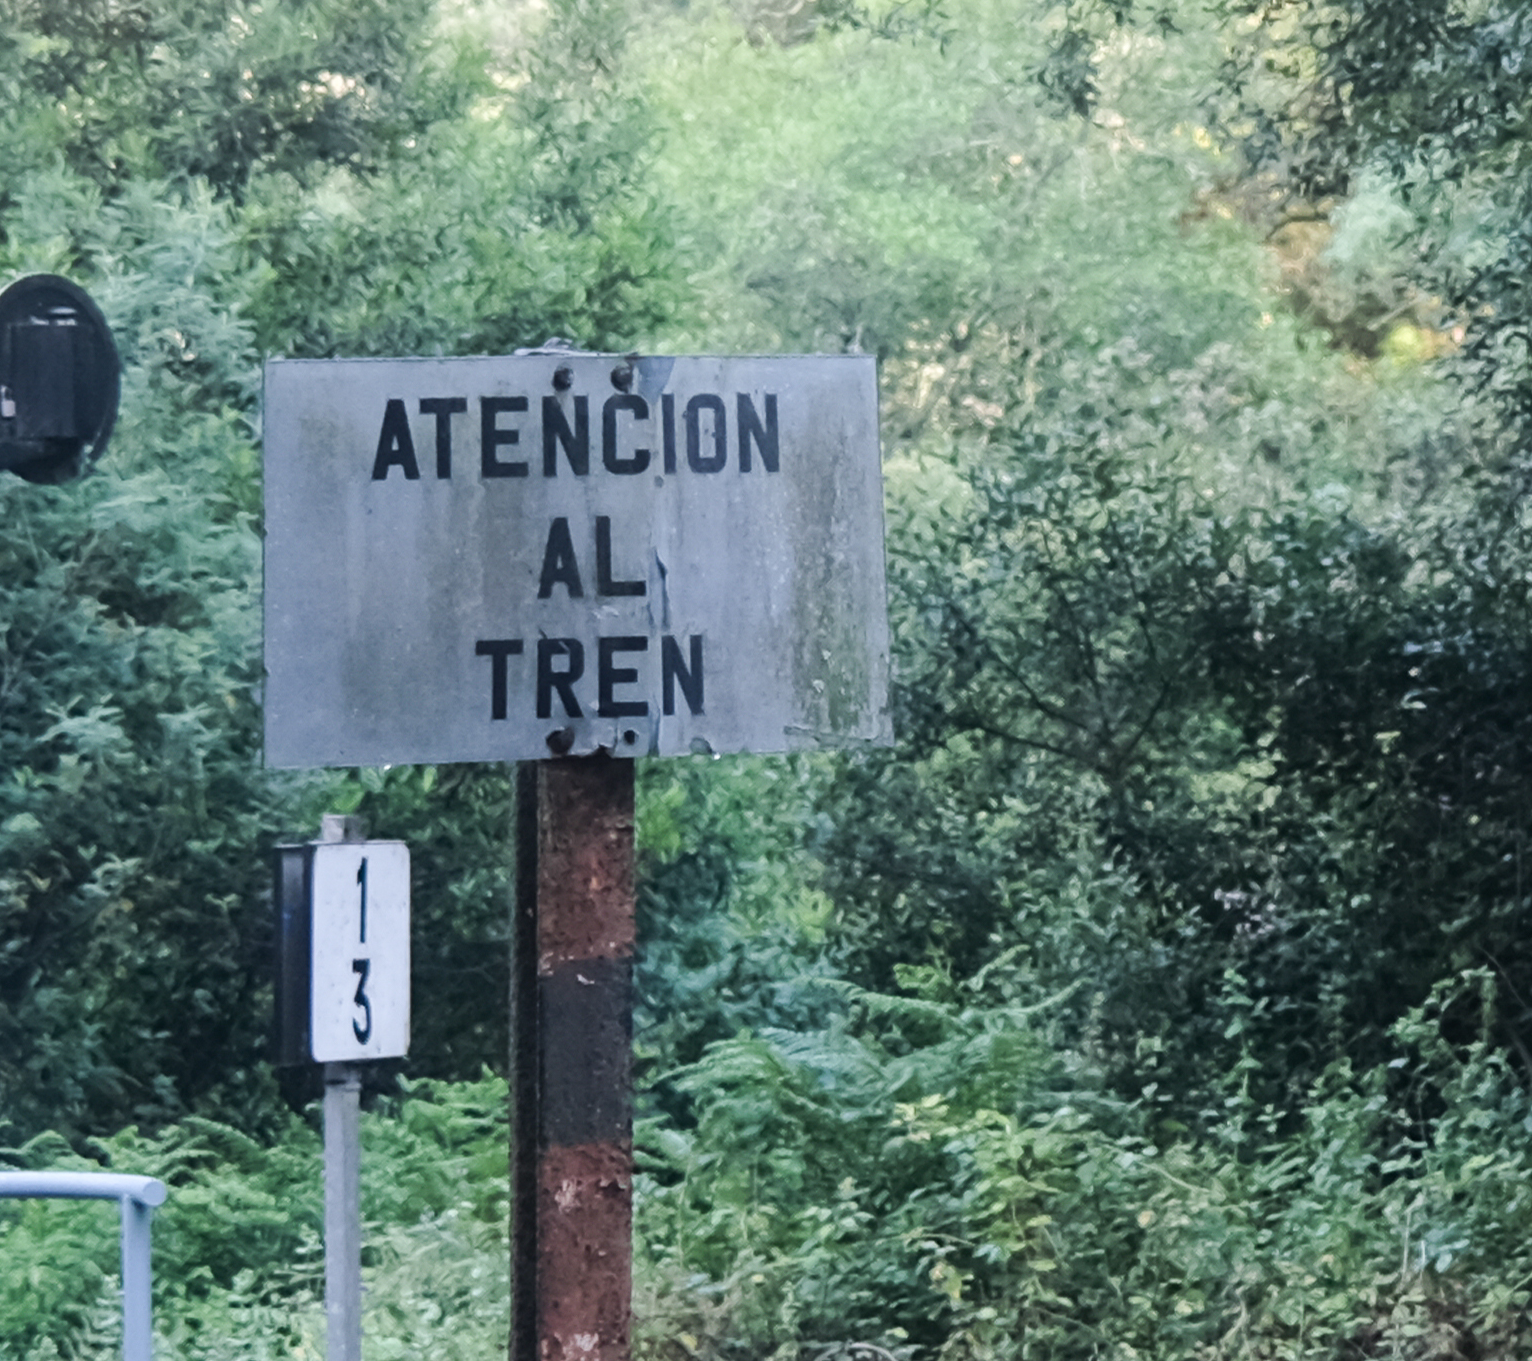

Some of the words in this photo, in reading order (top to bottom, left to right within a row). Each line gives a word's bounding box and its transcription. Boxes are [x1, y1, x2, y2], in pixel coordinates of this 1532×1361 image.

[371, 393, 780, 480] ATENCION
[537, 516, 647, 599] AL
[475, 634, 704, 720] TREN
